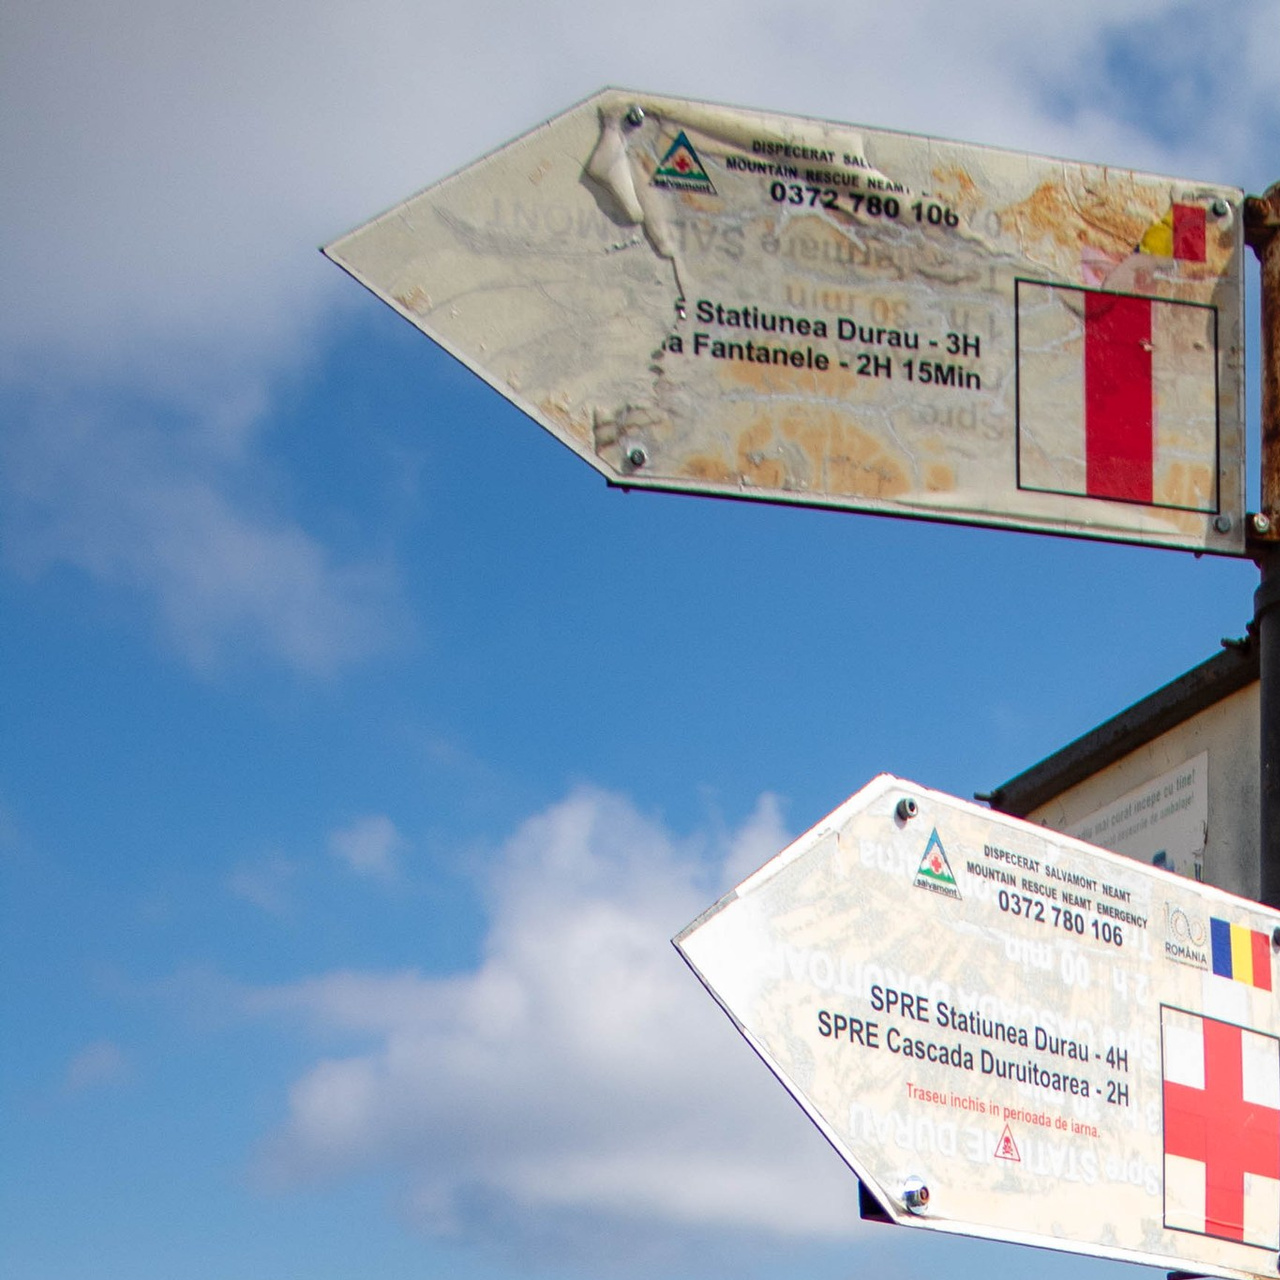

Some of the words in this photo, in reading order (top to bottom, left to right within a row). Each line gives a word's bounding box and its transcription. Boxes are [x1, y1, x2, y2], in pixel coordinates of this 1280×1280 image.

[726, 157, 798, 180] MOUNTAIN
[806, 169, 860, 187] RESCUE
[753, 140, 836, 164] DISPECERAT
[843, 154, 873, 170] SAL
[770, 180, 840, 211] 0372
[851, 193, 900, 220] 780
[910, 202, 960, 228] 106
[696, 299, 828, 340] Statiunea
[837, 317, 920, 350] Durau
[945, 332, 982, 359] 3H
[693, 332, 830, 372] Fantanele
[856, 353, 893, 379] 2H
[901, 358, 983, 391] 15Min
[916, 877, 958, 898] salvamont
[966, 860, 1017, 887] MOUNTAIN
[1021, 878, 1058, 901] RESCUE
[1061, 892, 1092, 912] NEAMT
[1096, 902, 1148, 930] EMERGENCY
[983, 844, 1040, 873] DISPECERAT
[1045, 865, 1098, 892] SALVAMONT
[1102, 884, 1132, 904] NEAMT
[999, 889, 1046, 924] 0372
[1051, 906, 1085, 935] 780
[1091, 918, 1124, 947] 106
[1165, 940, 1208, 965] ROMÂNIA
[870, 984, 930, 1023] SPRE
[936, 1001, 1029, 1047] Statiunea
[1034, 1025, 1090, 1063] Durau
[1105, 1045, 1130, 1073] 4H
[817, 1010, 880, 1049] SPRE
[886, 1026, 975, 1071] Cascada
[980, 1049, 1091, 1098] Duruitoarea
[1106, 1080, 1130, 1108] 2H
[906, 1082, 948, 1106] Traseu
[950, 1091, 987, 1115] inchis
[988, 1101, 1001, 1117] in
[1002, 1104, 1052, 1129] perioada
[1054, 1114, 1069, 1131] de
[1070, 1120, 1102, 1140] iarna.
